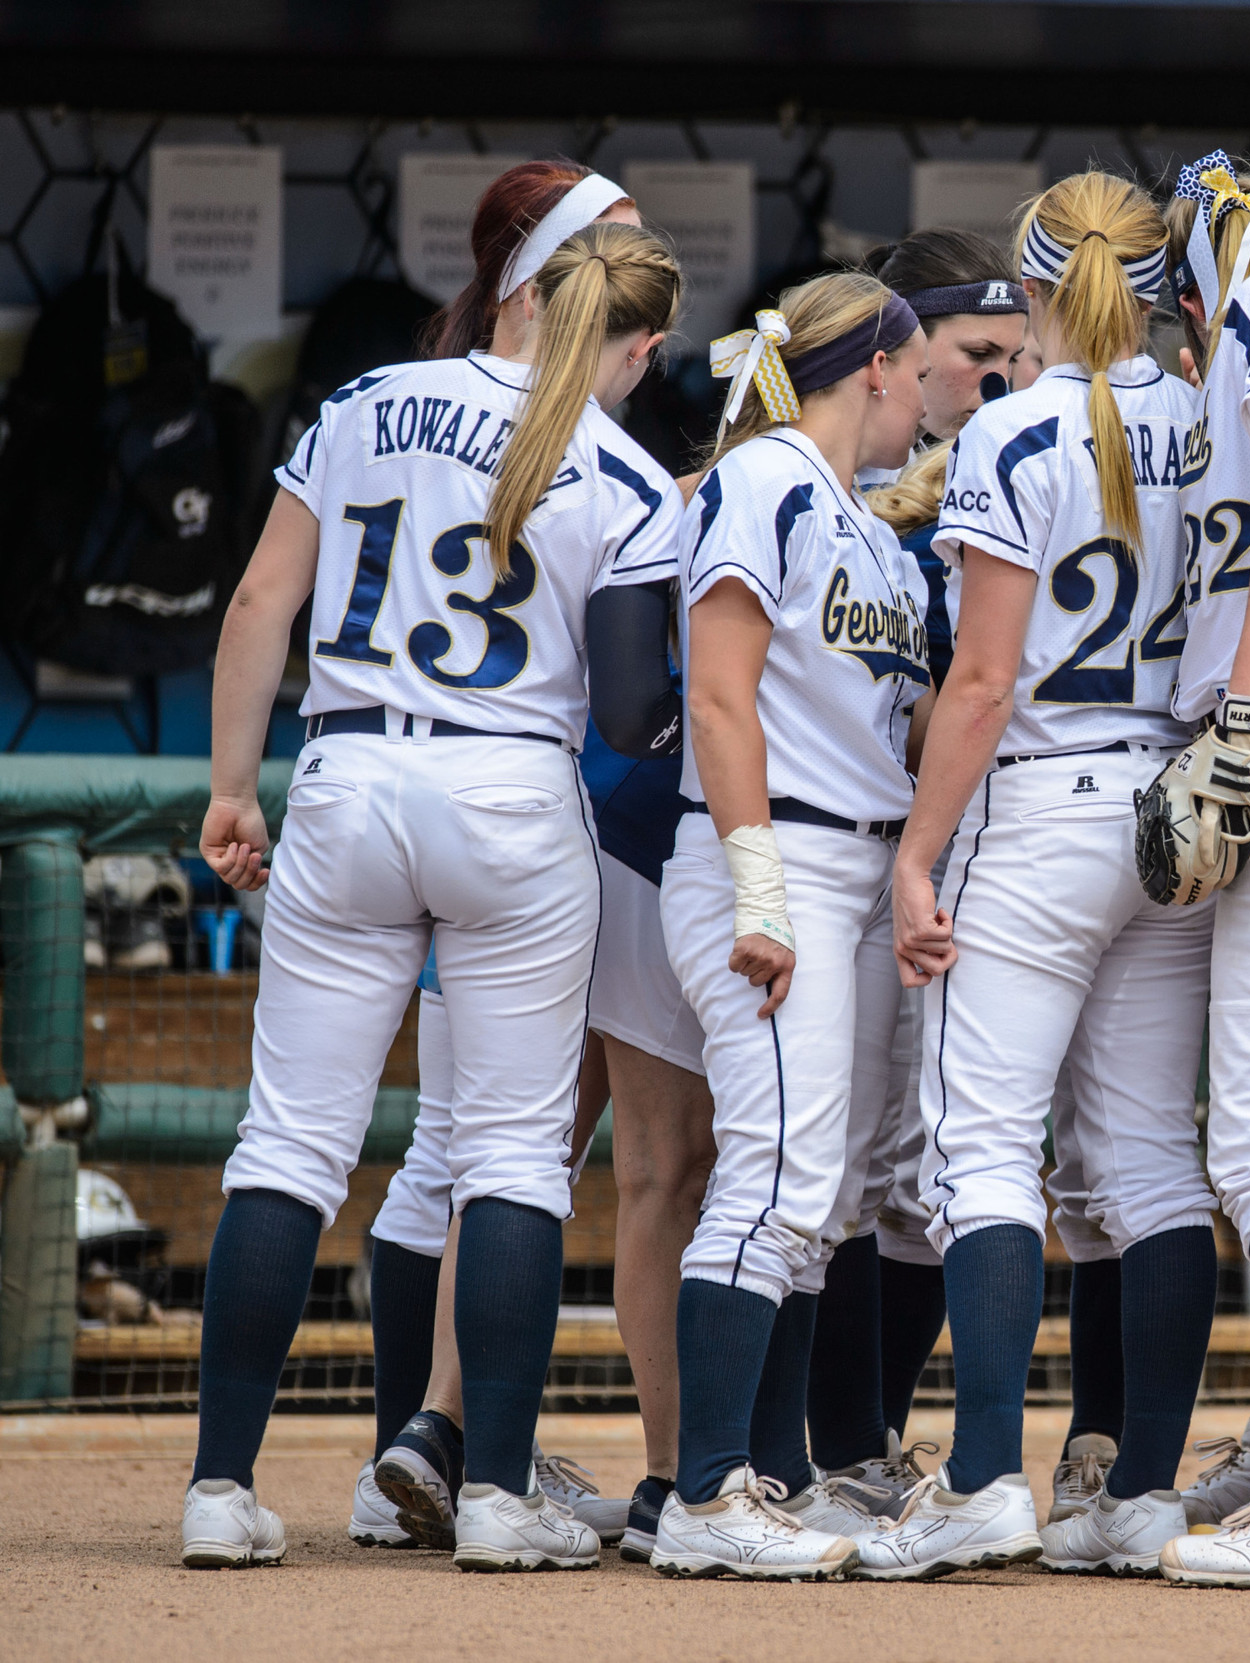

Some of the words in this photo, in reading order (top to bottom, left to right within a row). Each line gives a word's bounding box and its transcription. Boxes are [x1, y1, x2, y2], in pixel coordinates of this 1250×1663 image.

[980, 298, 1014, 306] RUSSELL
[943, 489, 991, 512] ACC
[314, 496, 539, 691] 13
